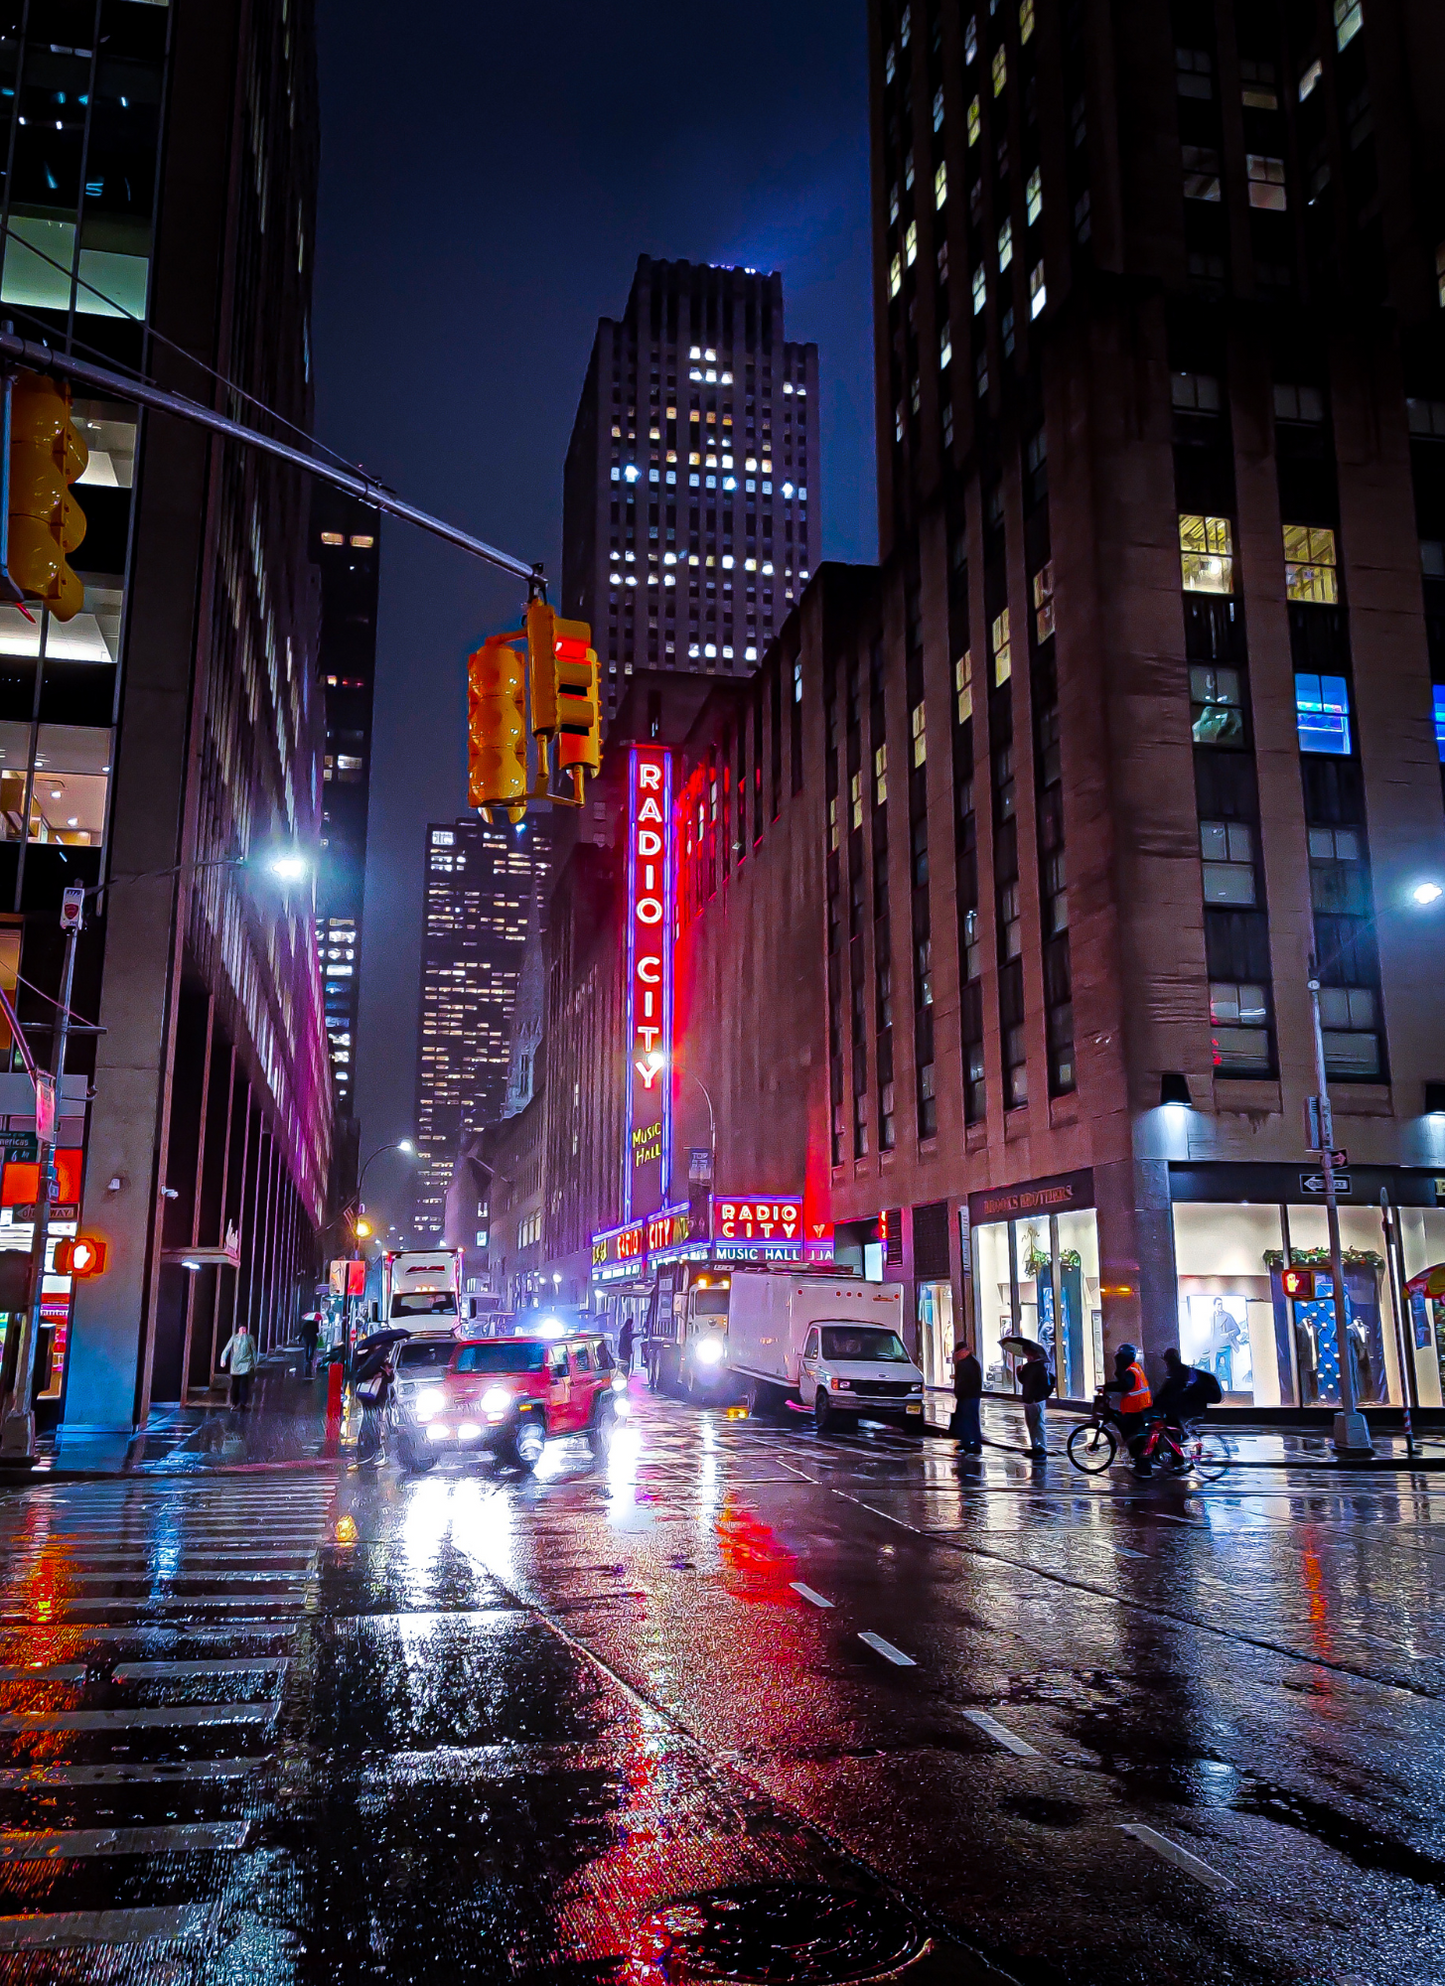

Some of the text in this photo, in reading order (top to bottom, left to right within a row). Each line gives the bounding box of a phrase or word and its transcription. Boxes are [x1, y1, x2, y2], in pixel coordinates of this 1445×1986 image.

[635, 763, 664, 1088] RADIO CITY
[632, 1122, 661, 1149] MUSIC
[11, 1150, 18, 1162] 6
[636, 1143, 661, 1168] HALL
[50, 1208, 71, 1218] WAY
[721, 1204, 798, 1221] RADIO
[649, 1217, 672, 1250] CITY
[721, 1222, 797, 1239] CITY
[716, 1248, 759, 1260] MUSIC
[765, 1248, 800, 1260] HALL
